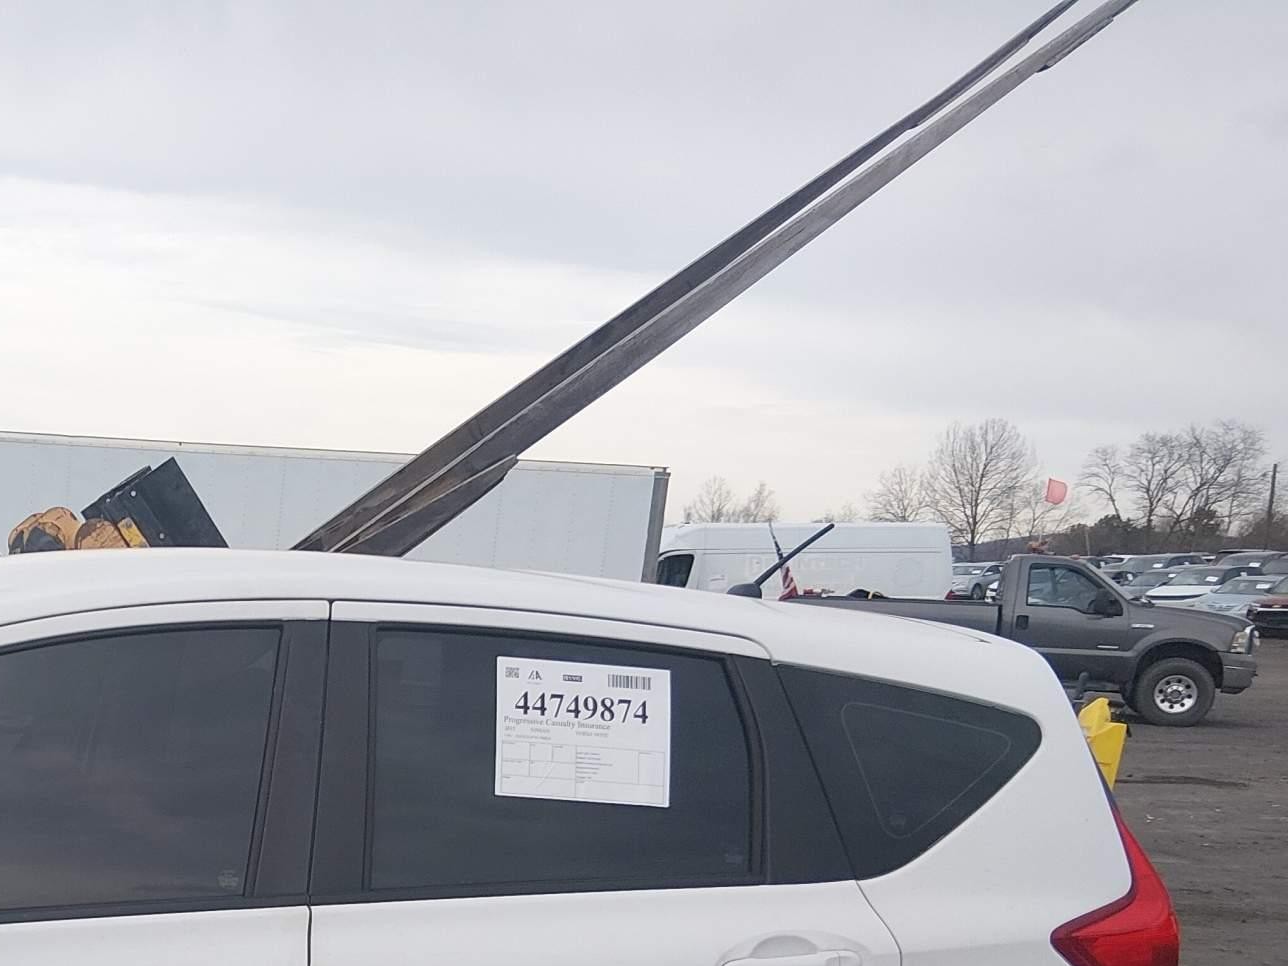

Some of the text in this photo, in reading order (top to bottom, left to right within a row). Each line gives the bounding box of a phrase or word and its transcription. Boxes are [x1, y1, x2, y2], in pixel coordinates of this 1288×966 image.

[514, 691, 649, 724] 44749874
[503, 715, 611, 730] Progressive Casualty Insurance
